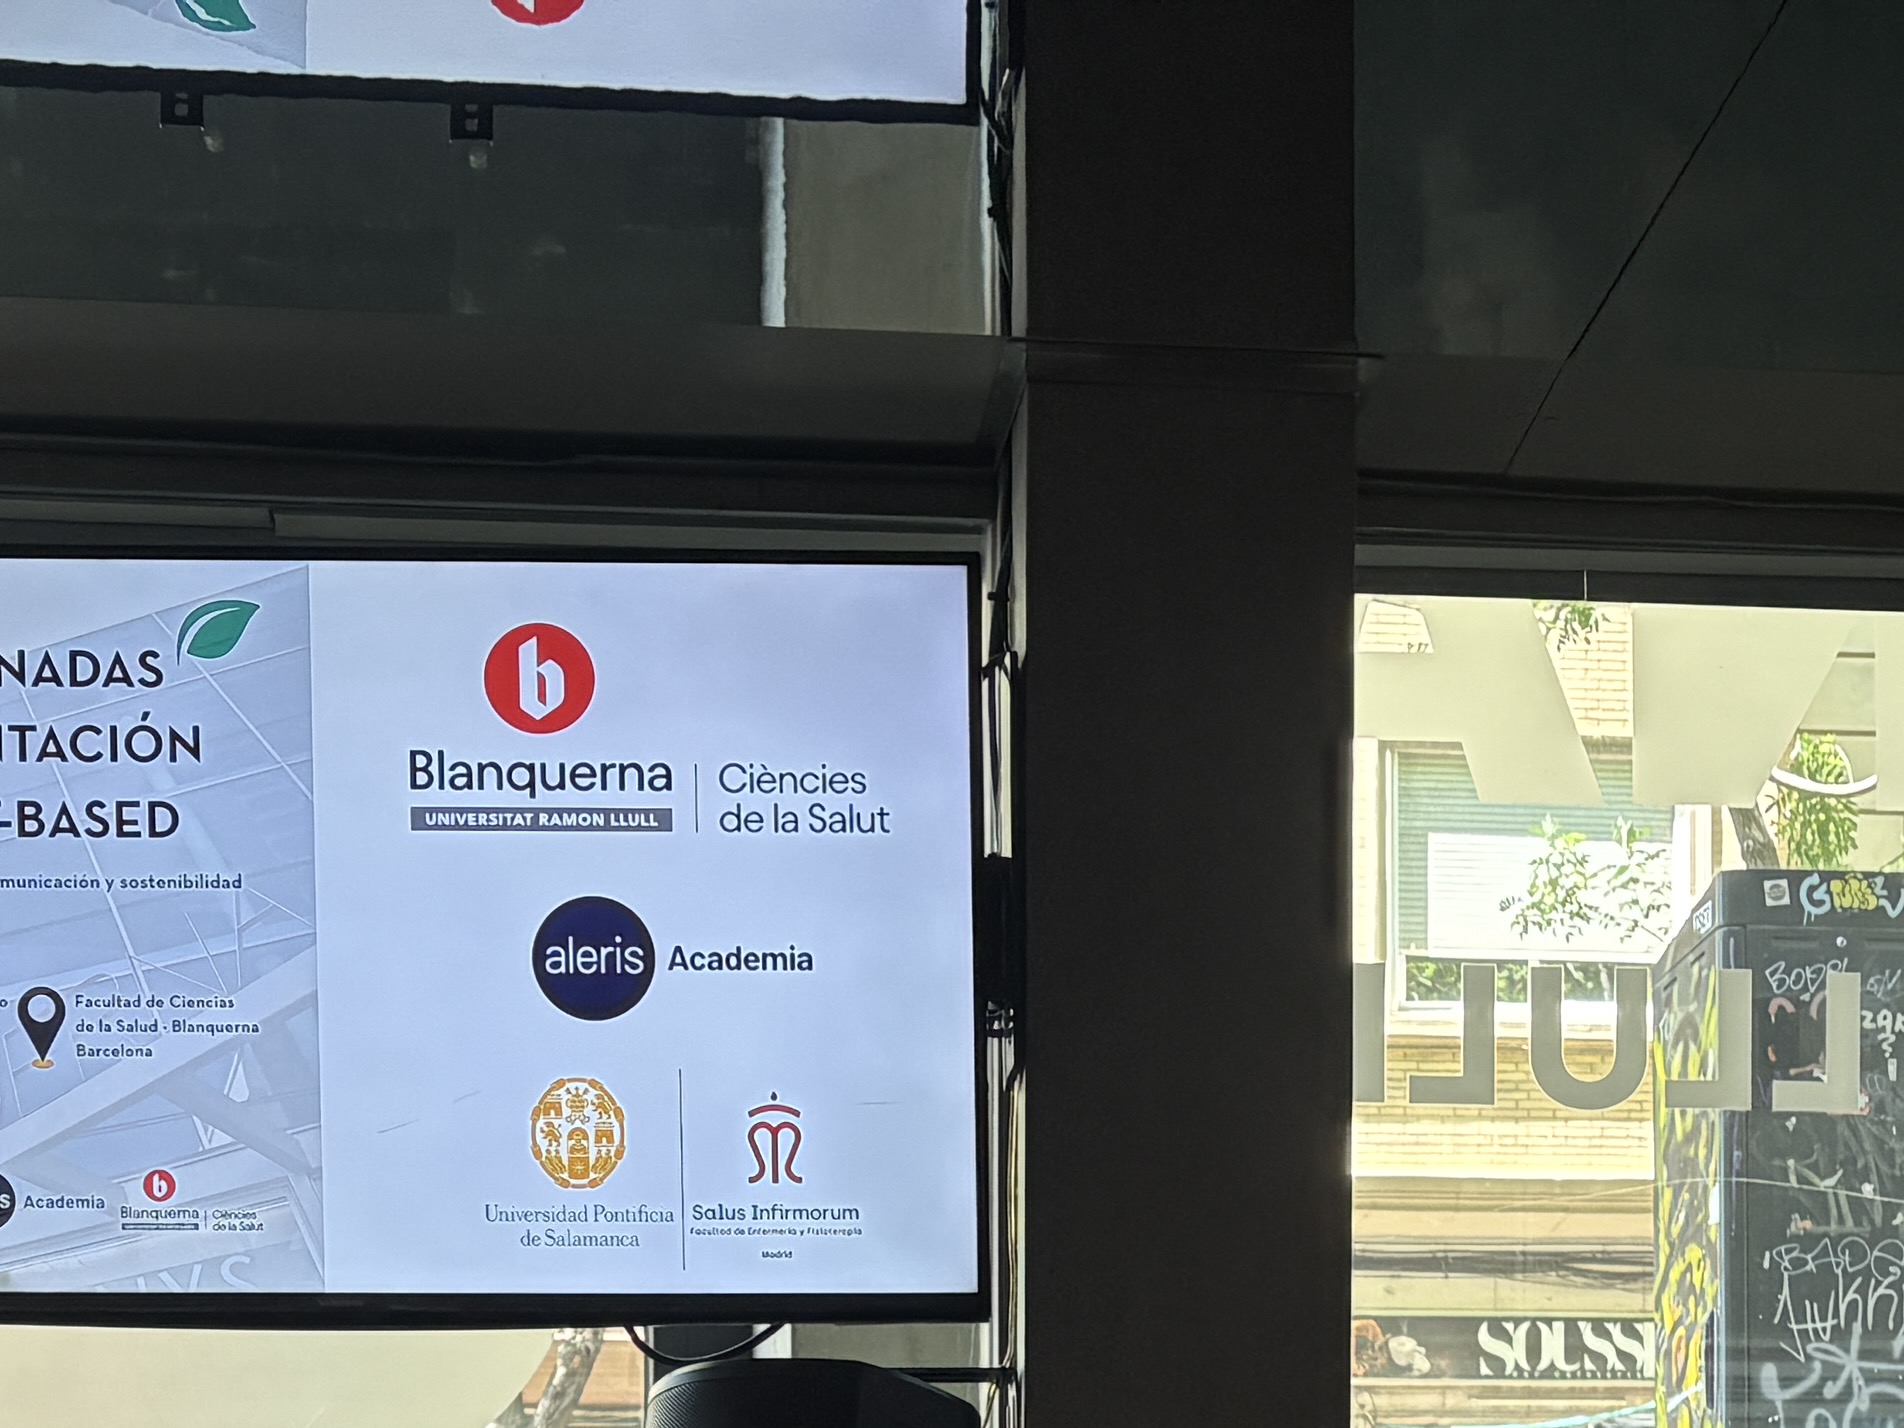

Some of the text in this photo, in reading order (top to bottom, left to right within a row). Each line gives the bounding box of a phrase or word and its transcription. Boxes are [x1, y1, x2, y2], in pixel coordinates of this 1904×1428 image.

[409, 749, 674, 799] Blanquerna
[718, 762, 868, 795] Ciències
[424, 811, 659, 829] UNIVERSITAT RAMON LLULL
[718, 802, 892, 834] de la Salut
[104, 877, 115, 892] y
[119, 872, 243, 890] sostenibilidad
[544, 935, 645, 975] aleris
[667, 944, 814, 972] Academia
[75, 994, 235, 1009] Facultad de Ciencias
[75, 1018, 95, 1033] de
[98, 1018, 112, 1033] la
[116, 1018, 159, 1033] Salud
[172, 1019, 260, 1036] Blanquerna
[75, 1043, 153, 1058] Barcelona
[23, 1194, 106, 1210] Academia
[691, 1203, 860, 1221] Salus Infirmorum
[120, 1206, 200, 1221] Blanquerna
[484, 1203, 675, 1224] Universidad Pontificia
[519, 1228, 641, 1248] de Salamanca
